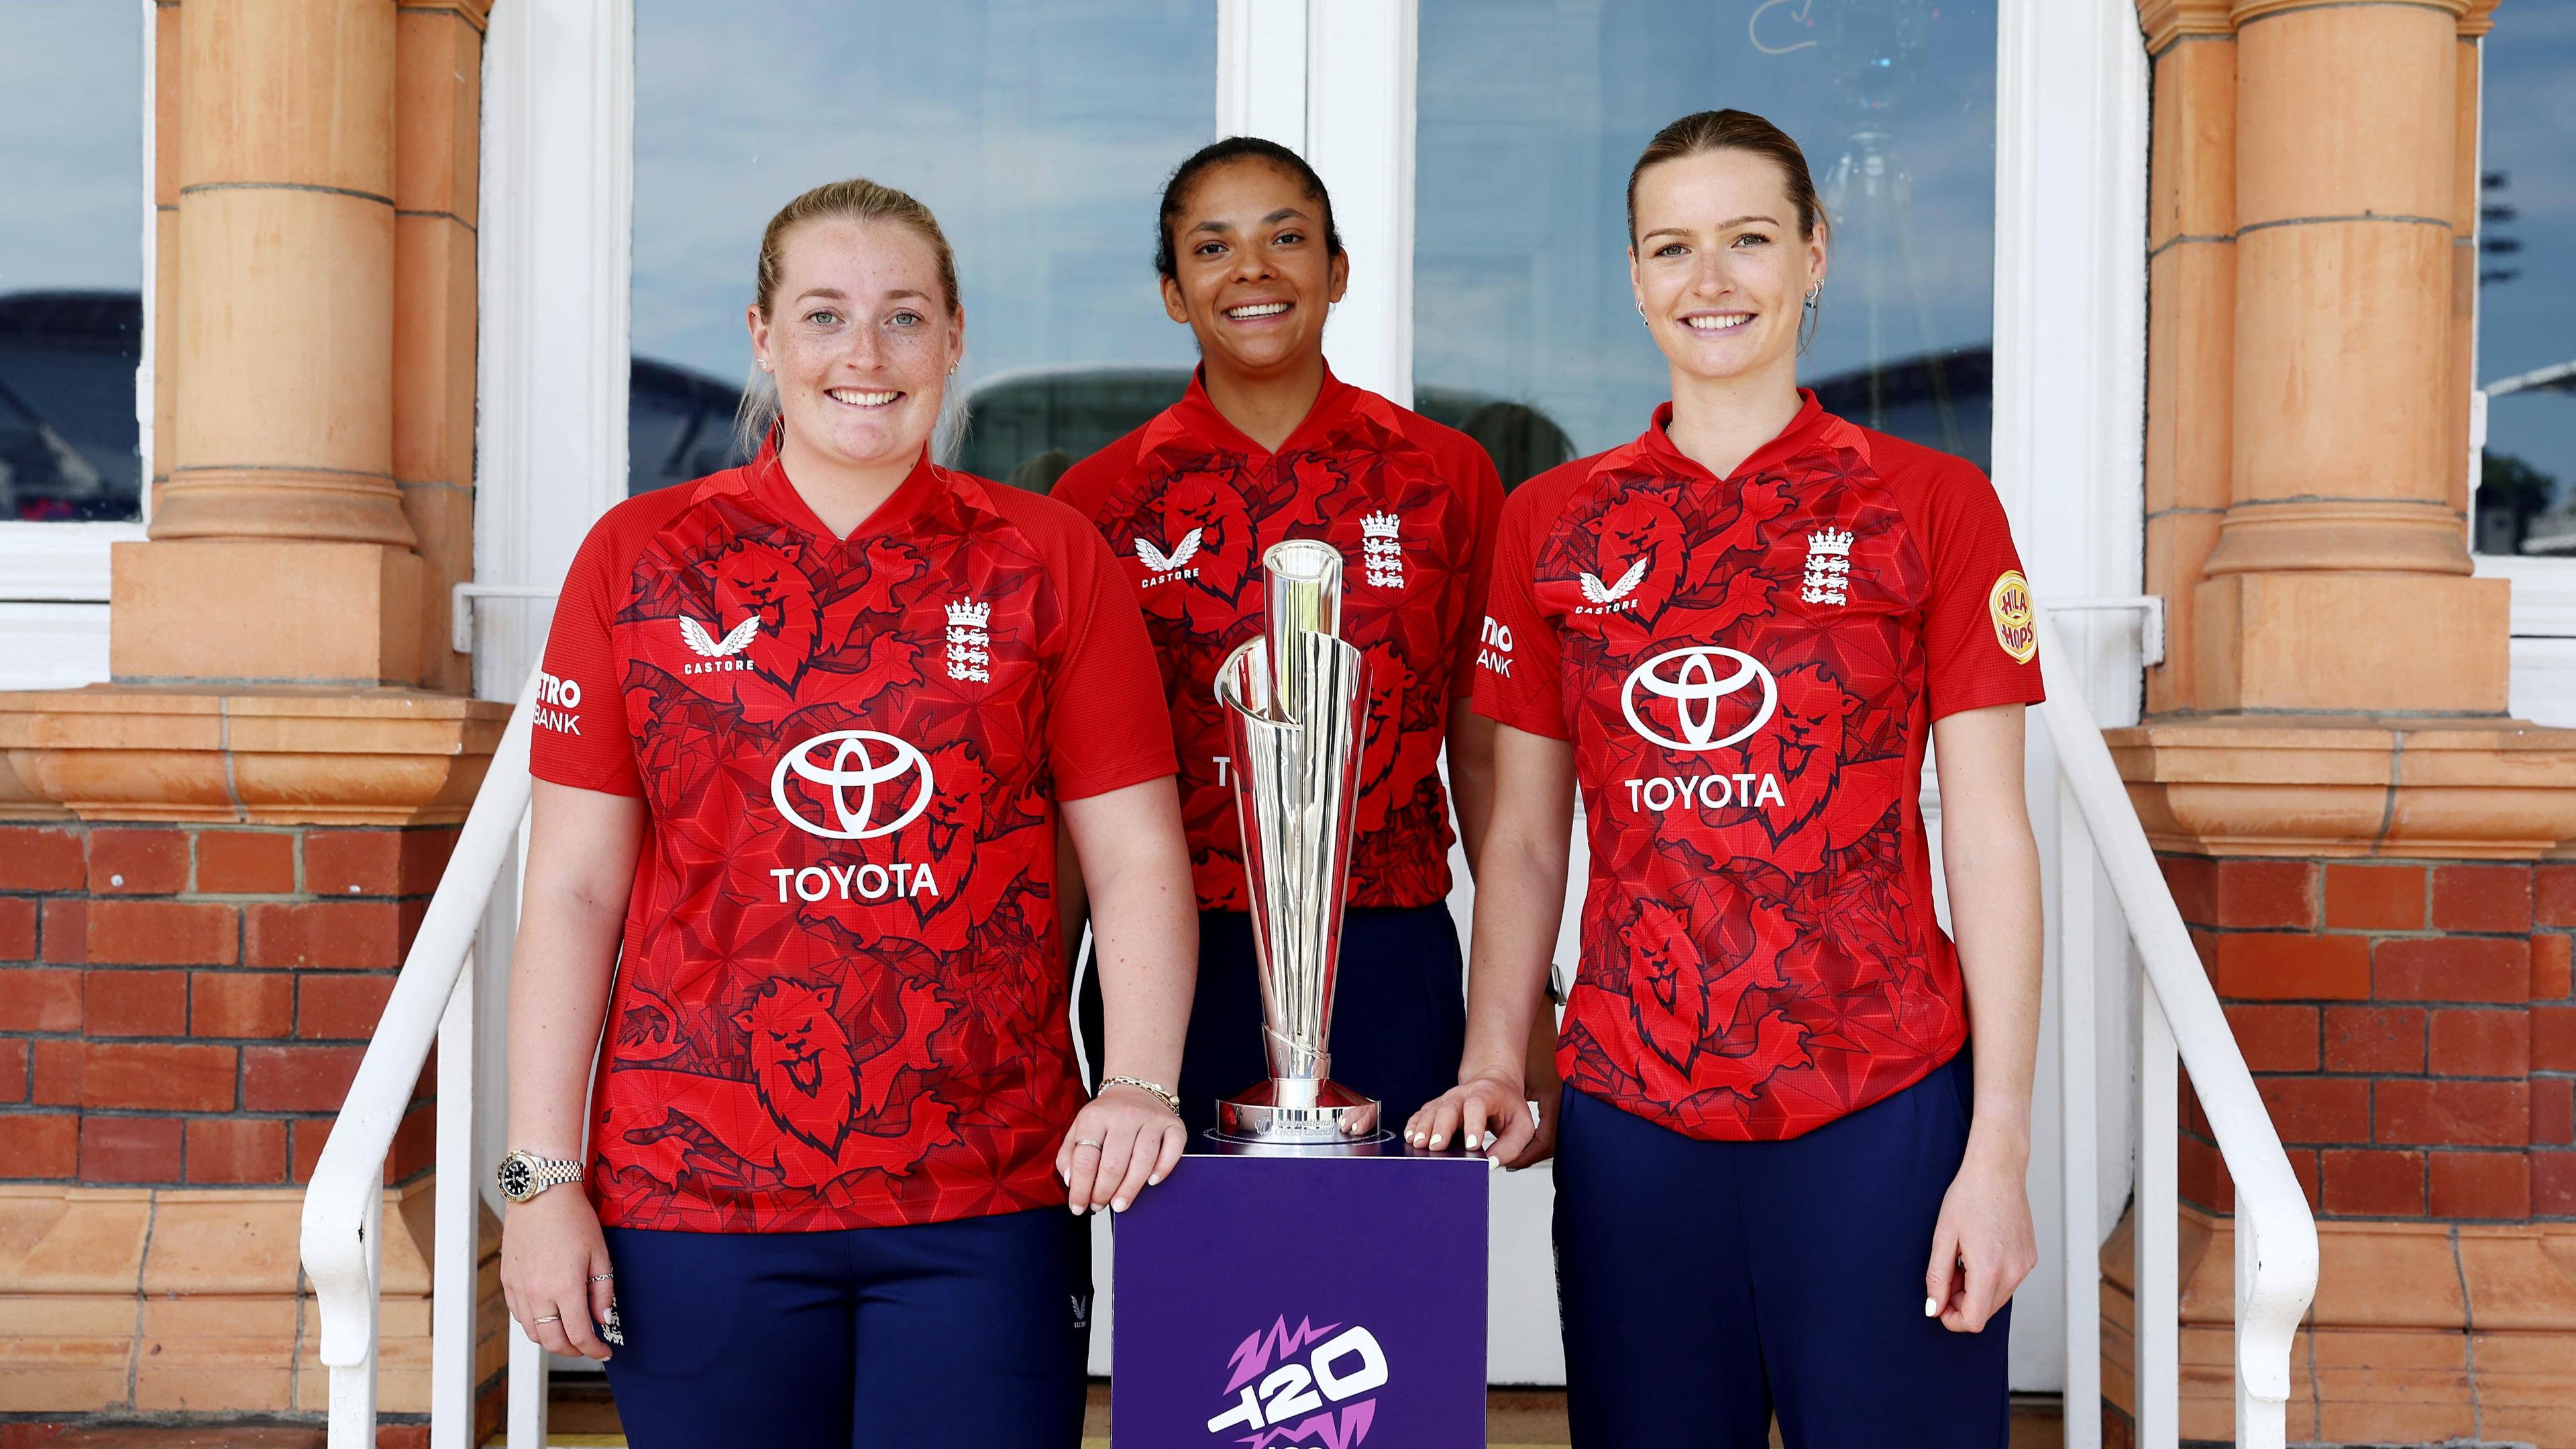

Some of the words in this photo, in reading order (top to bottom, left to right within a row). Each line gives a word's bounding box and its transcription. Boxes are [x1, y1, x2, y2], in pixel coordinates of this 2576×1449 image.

[1142, 568, 1199, 588] CASTORE
[1574, 598, 1638, 614] CASTORE
[1481, 615, 1513, 652] TRO
[684, 659, 754, 675] CASTORE
[1476, 648, 1513, 678] ANK
[537, 671, 582, 708] TRO
[534, 703, 582, 736] BANK
[1624, 773, 1786, 812] TOYOTA
[769, 863, 939, 903] TOYOTA
[1275, 1128, 1303, 1137] Cricket
[1303, 1127, 1335, 1137] Council
[1208, 1326, 1389, 1433] T20
